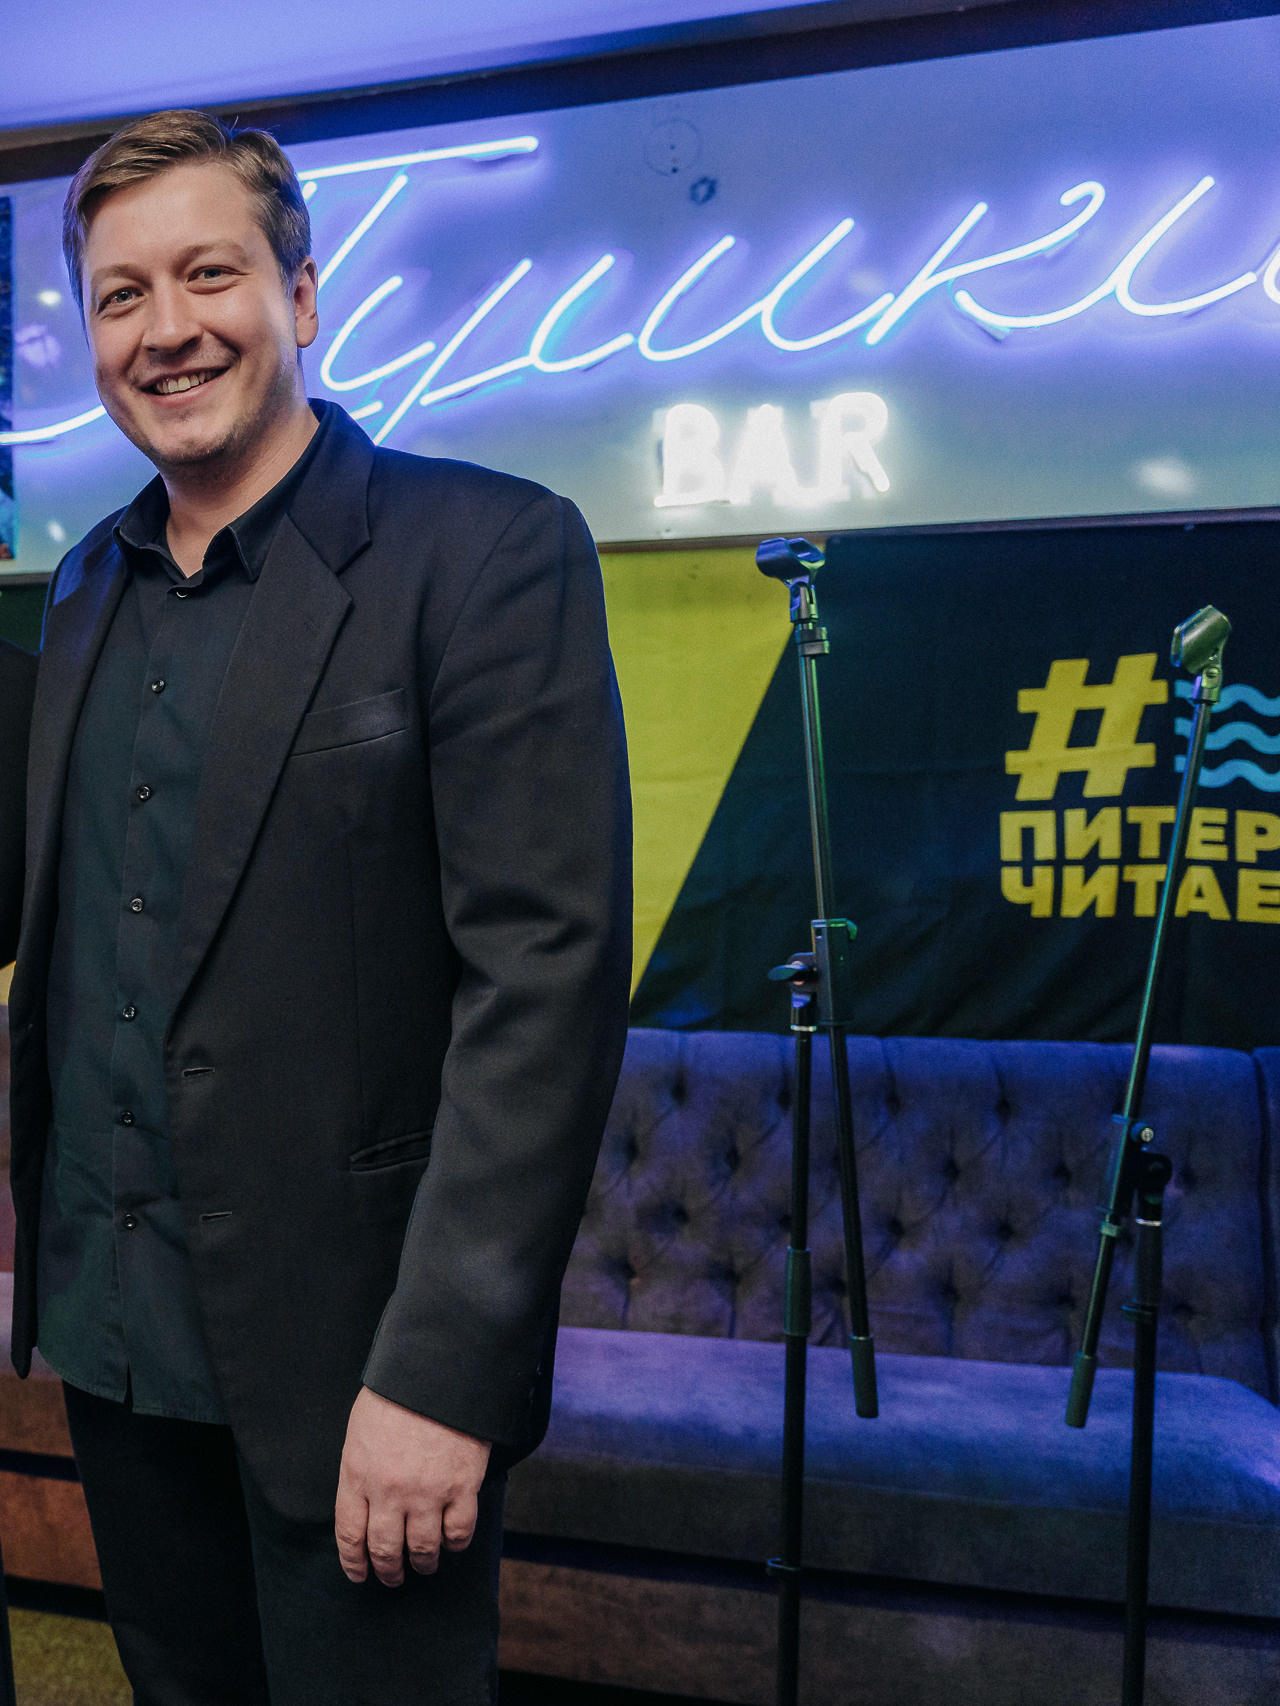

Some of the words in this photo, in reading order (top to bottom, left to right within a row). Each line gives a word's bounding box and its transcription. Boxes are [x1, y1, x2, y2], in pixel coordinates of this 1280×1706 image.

[654, 391, 891, 508] BAR
[1000, 806, 1280, 863] ПИТЕР
[1001, 864, 1280, 924] ЧИТАЕ
